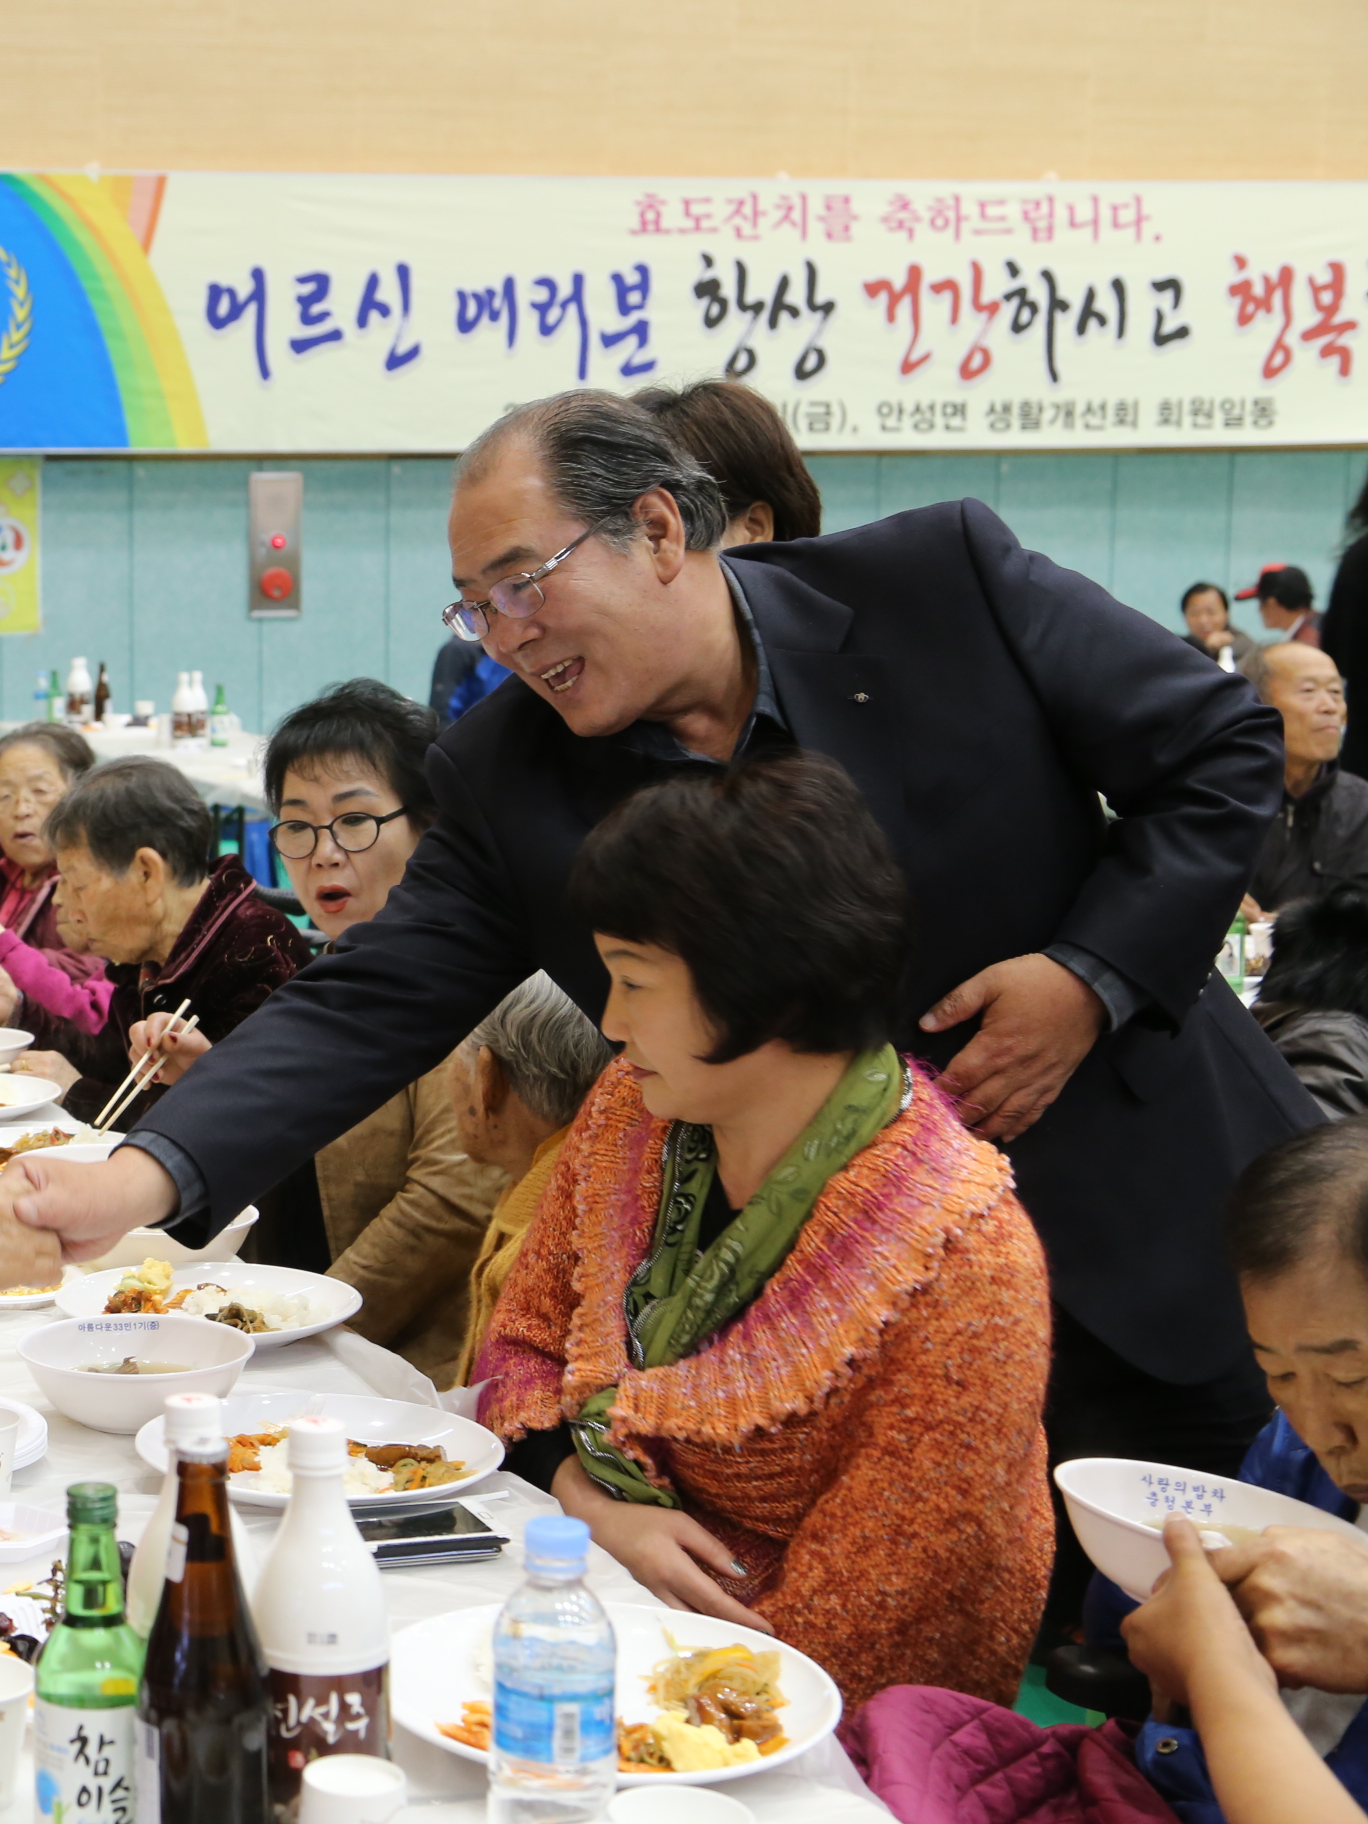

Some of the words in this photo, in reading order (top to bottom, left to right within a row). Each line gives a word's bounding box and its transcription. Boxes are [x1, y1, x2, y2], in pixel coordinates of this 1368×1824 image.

[630, 192, 859, 242] 효도잔치를
[880, 193, 1162, 243] 축하드립니다.
[204, 260, 422, 382] 어르신
[455, 262, 658, 380] 여러분
[692, 252, 838, 382] 항상
[1228, 253, 1368, 382] 행복
[877, 401, 967, 432] 안성면
[986, 400, 1138, 431] 생활개선회
[1157, 398, 1275, 429] 회원일동
